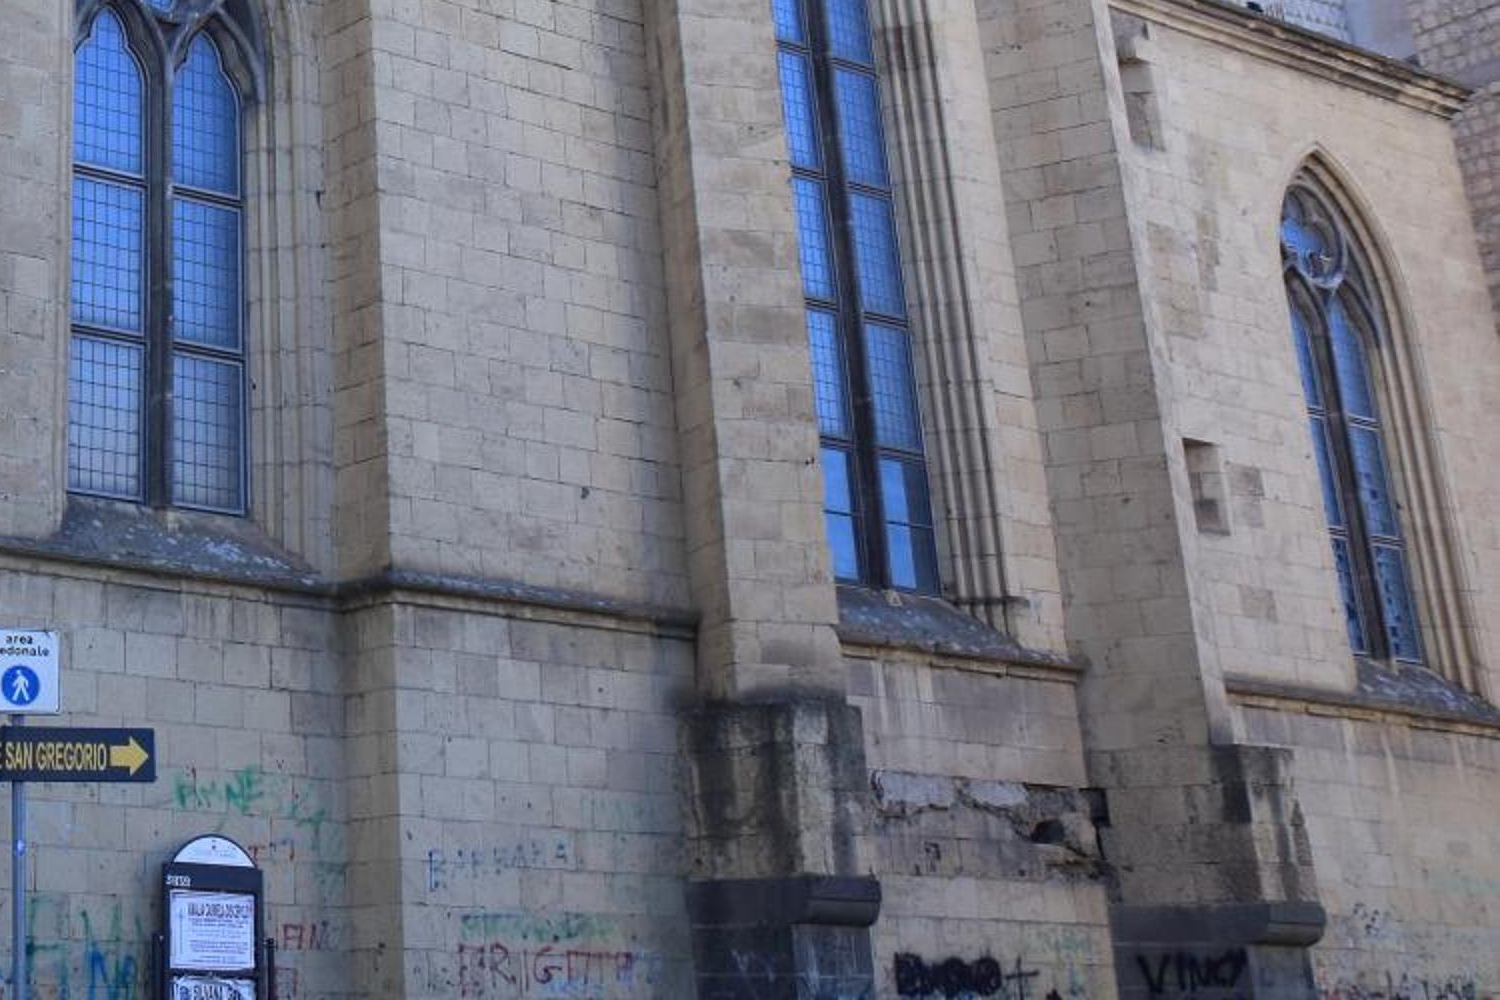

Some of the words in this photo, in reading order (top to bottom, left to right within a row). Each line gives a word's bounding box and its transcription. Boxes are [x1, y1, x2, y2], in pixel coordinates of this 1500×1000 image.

[5, 635, 33, 645] area
[5, 740, 33, 770] SAN
[35, 742, 107, 771] GREGORIO
